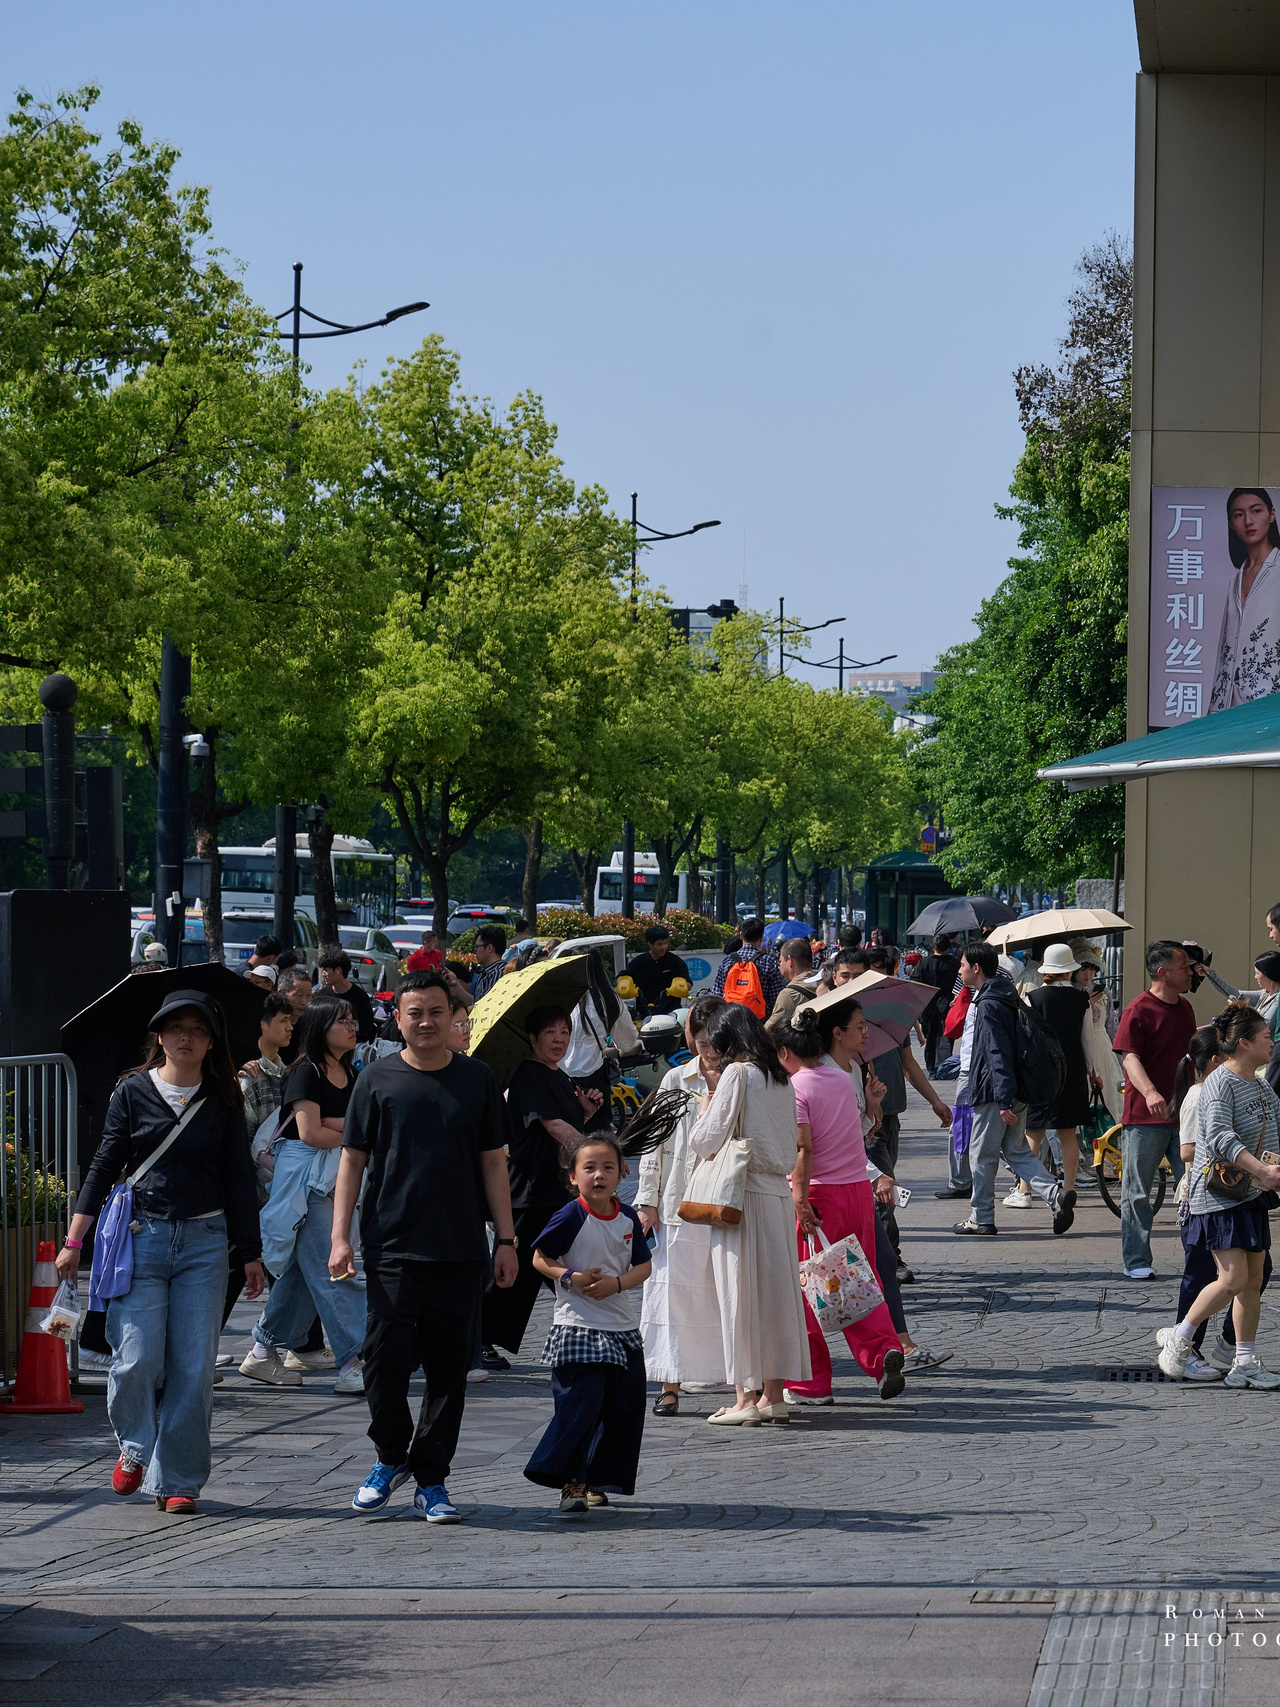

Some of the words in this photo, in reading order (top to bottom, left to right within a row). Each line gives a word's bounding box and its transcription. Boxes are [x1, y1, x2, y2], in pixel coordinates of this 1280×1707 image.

[1164, 503, 1206, 719] 万事利丝绸
